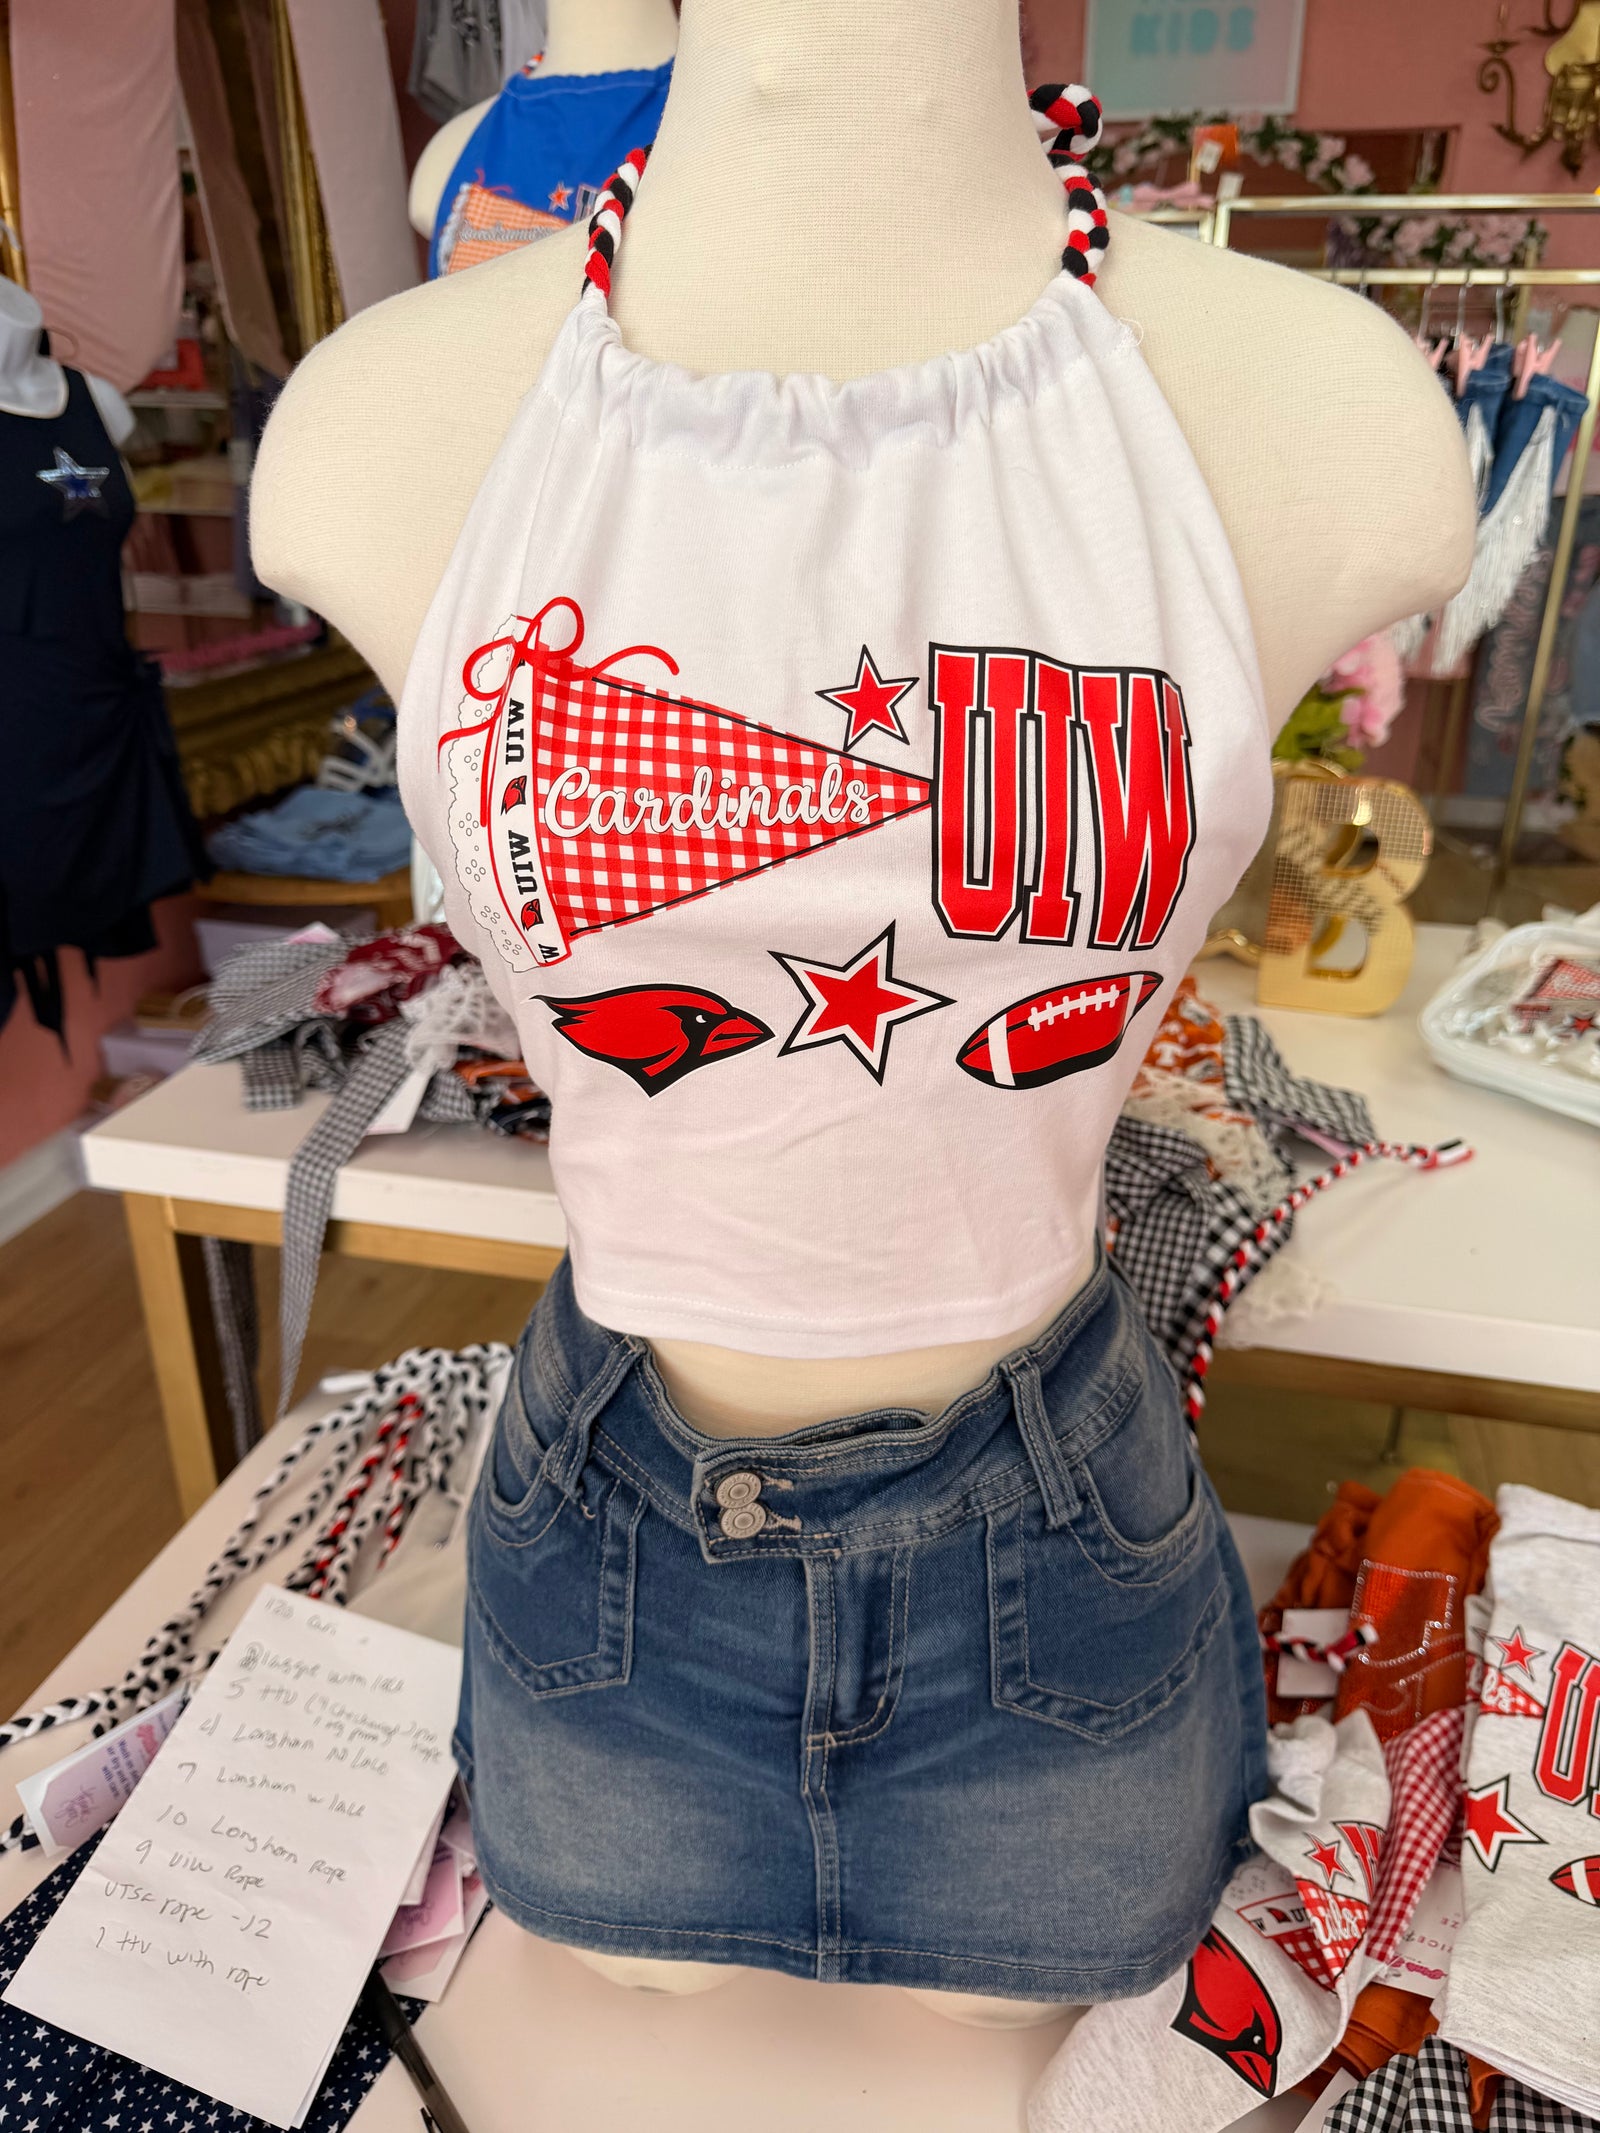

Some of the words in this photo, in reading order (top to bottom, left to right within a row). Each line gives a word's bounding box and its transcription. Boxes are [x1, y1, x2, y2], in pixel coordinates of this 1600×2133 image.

[1131, 6, 1256, 56] KIDS
[504, 697, 526, 765] UIW
[544, 762, 880, 838] Cardinals
[928, 641, 1197, 952] UIW
[508, 830, 536, 896] UIW
[224, 1677, 250, 1700] 5
[177, 1761, 199, 1783] 7
[135, 1839, 153, 1865] 9
[156, 1804, 188, 1827] 10
[210, 1814, 298, 1864] Longhorn
[158, 1898, 213, 1923] rope
[167, 1950, 215, 1975] with
[225, 1966, 271, 1992] rope
